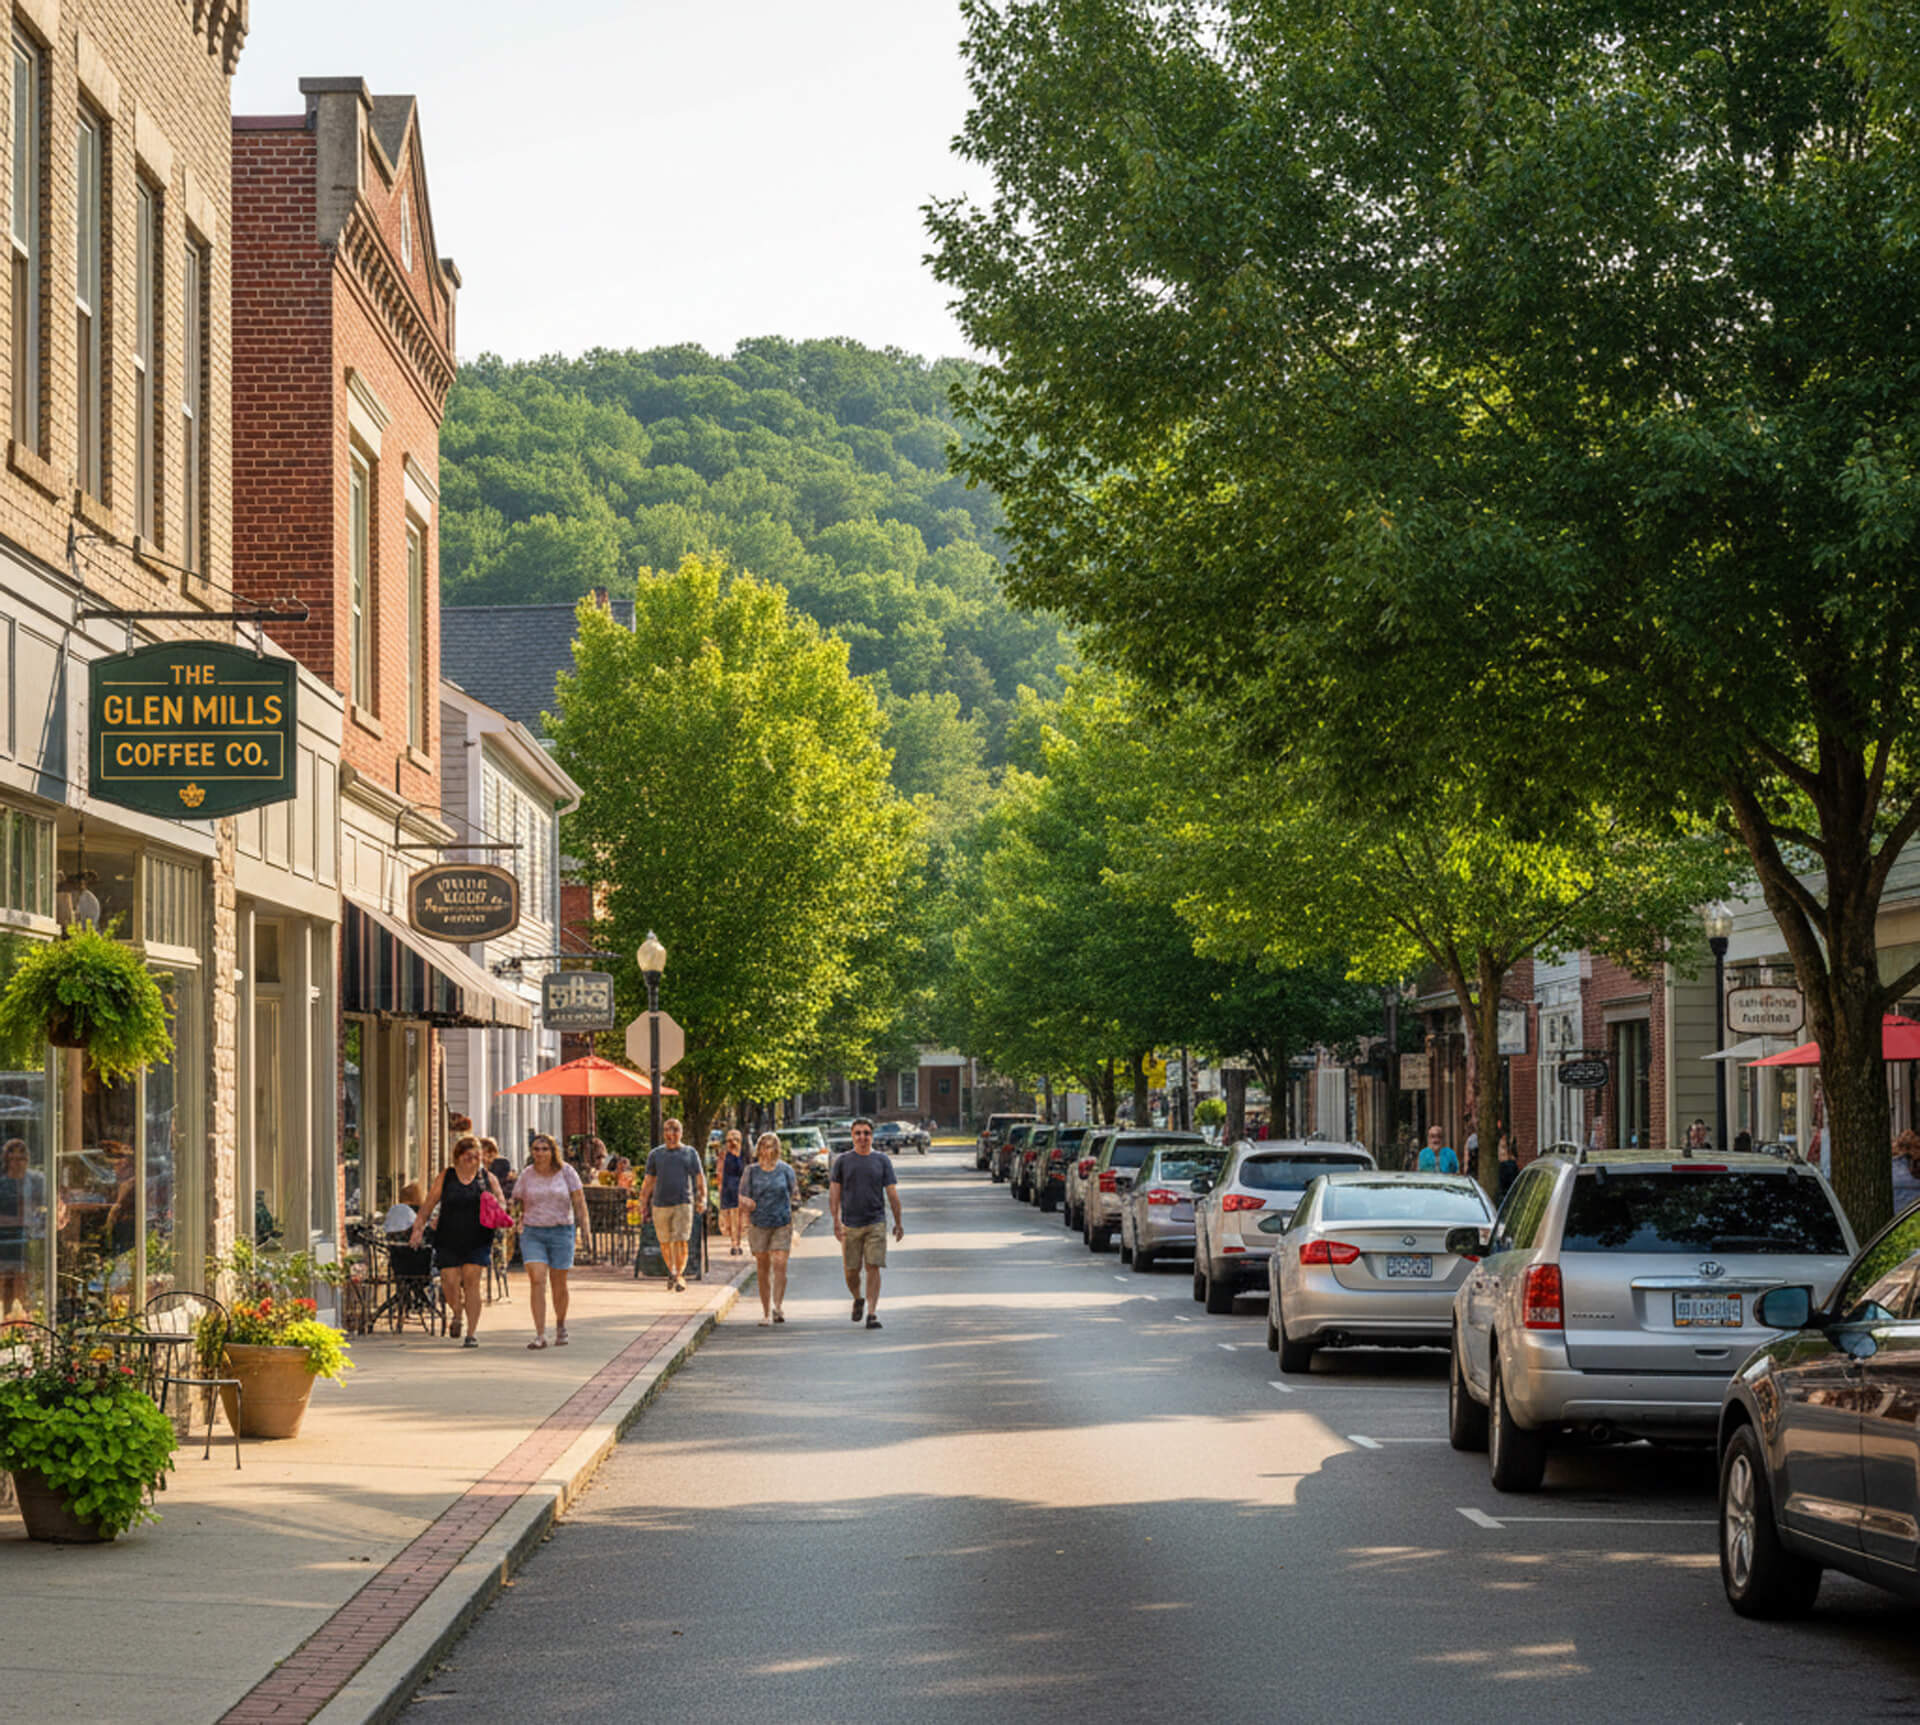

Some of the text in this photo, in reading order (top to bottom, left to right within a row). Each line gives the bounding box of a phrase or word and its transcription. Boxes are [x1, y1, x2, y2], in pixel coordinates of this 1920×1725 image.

[169, 665, 216, 685] THE
[103, 695, 283, 725] GLEN MILLS
[116, 742, 269, 767] COFFEE CO.
